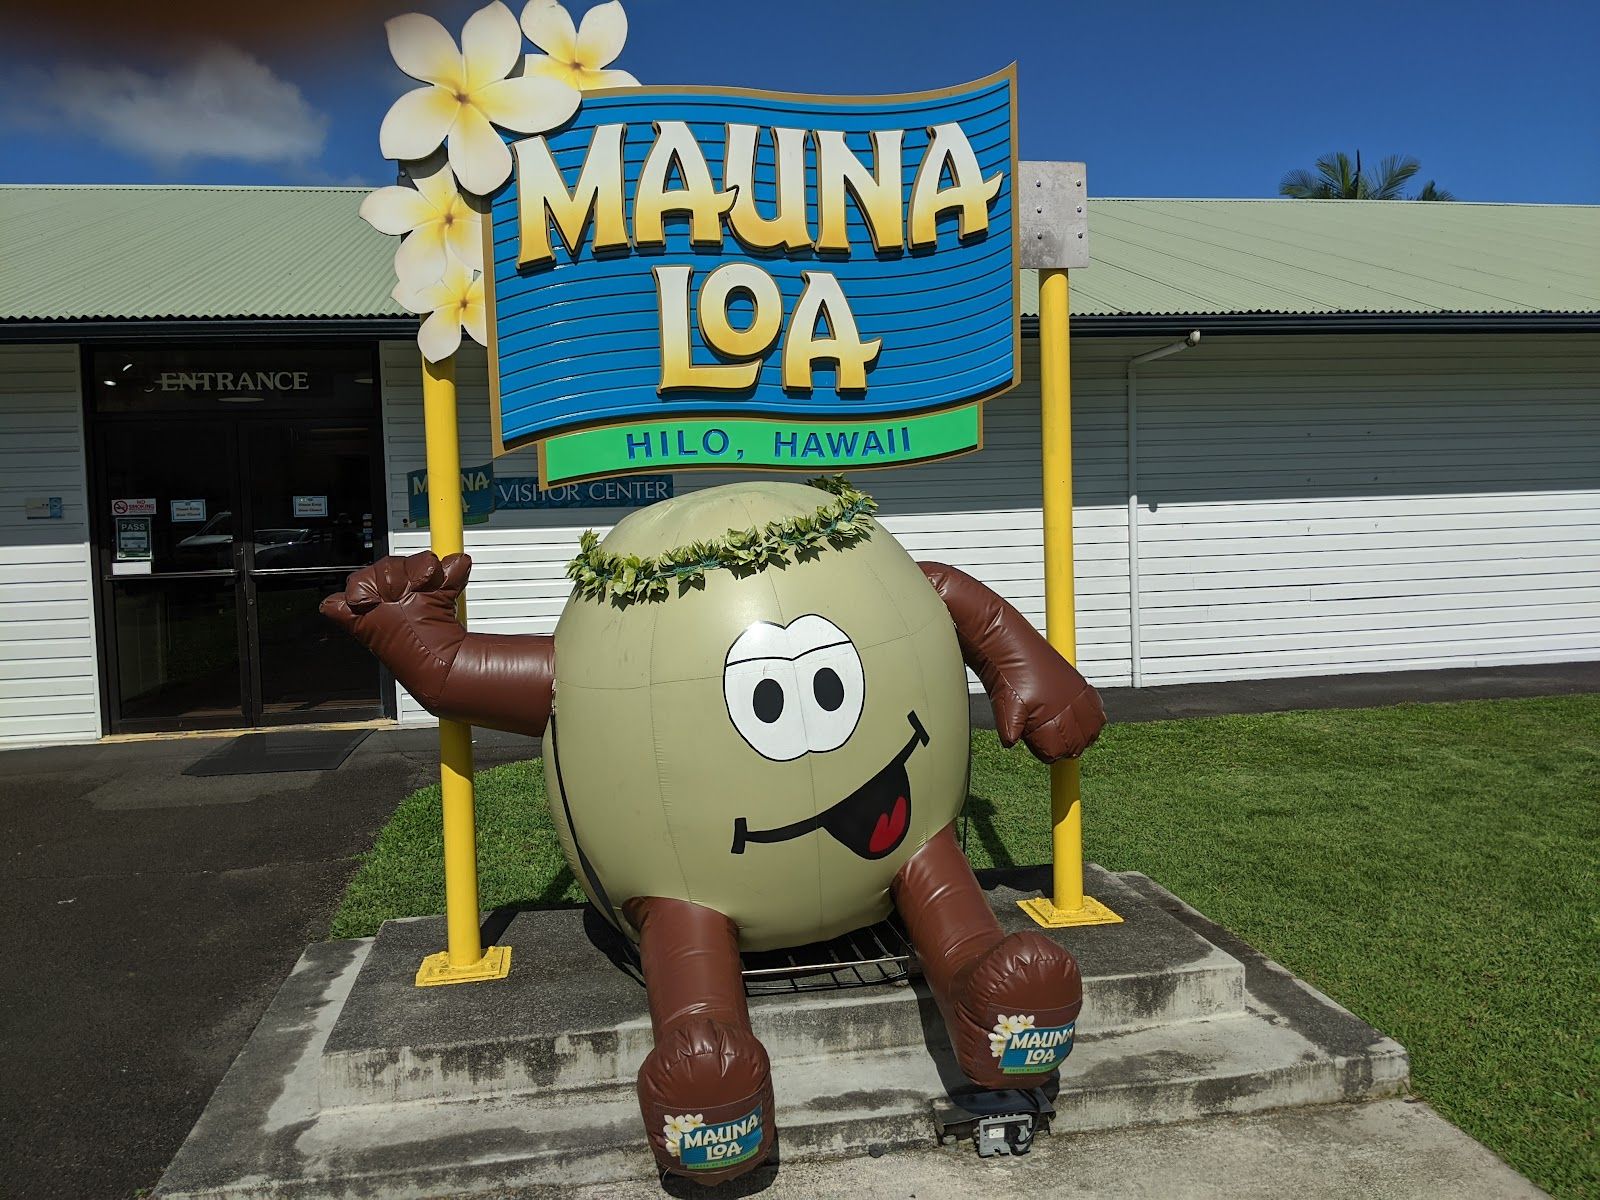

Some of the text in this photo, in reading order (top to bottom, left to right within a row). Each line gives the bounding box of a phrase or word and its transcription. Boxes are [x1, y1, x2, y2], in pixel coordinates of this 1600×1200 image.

[511, 120, 1003, 273] MAUNA
[652, 263, 882, 395] LOA
[160, 372, 310, 391] ENTRANCE
[625, 427, 911, 460] HILO, HAWAII
[413, 472, 490, 496] MNA
[589, 481, 669, 500] CENTER
[121, 523, 145, 531] PASS
[1025, 1049, 1056, 1065] LOA
[684, 1114, 759, 1149] MAUNA
[706, 1141, 743, 1160] LOA
